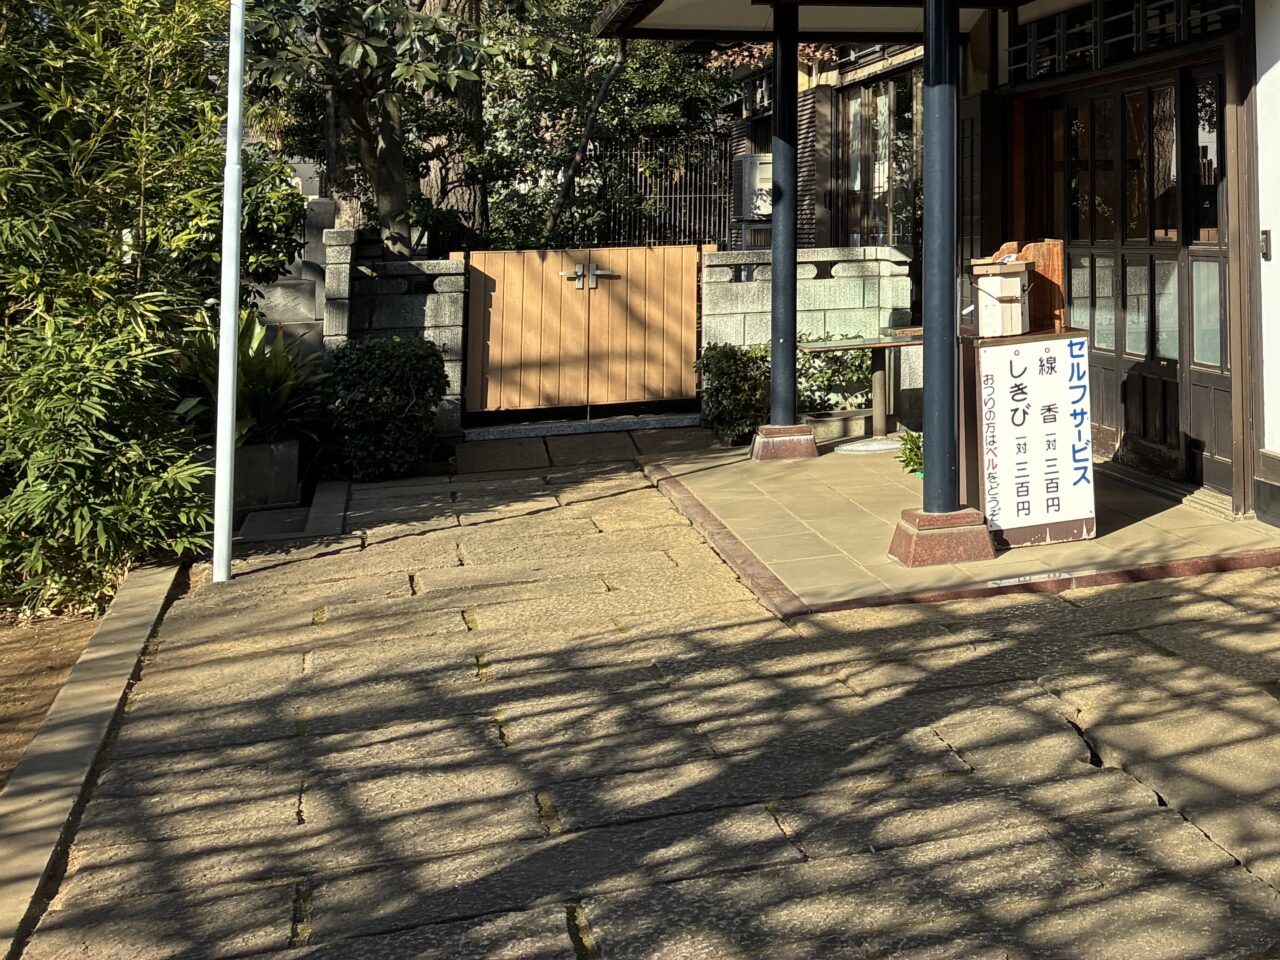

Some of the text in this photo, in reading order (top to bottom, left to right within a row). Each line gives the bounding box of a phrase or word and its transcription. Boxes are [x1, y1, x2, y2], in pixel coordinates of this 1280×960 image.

[1009, 359, 1031, 428] しきび
[1067, 339, 1091, 487] セルフサービス
